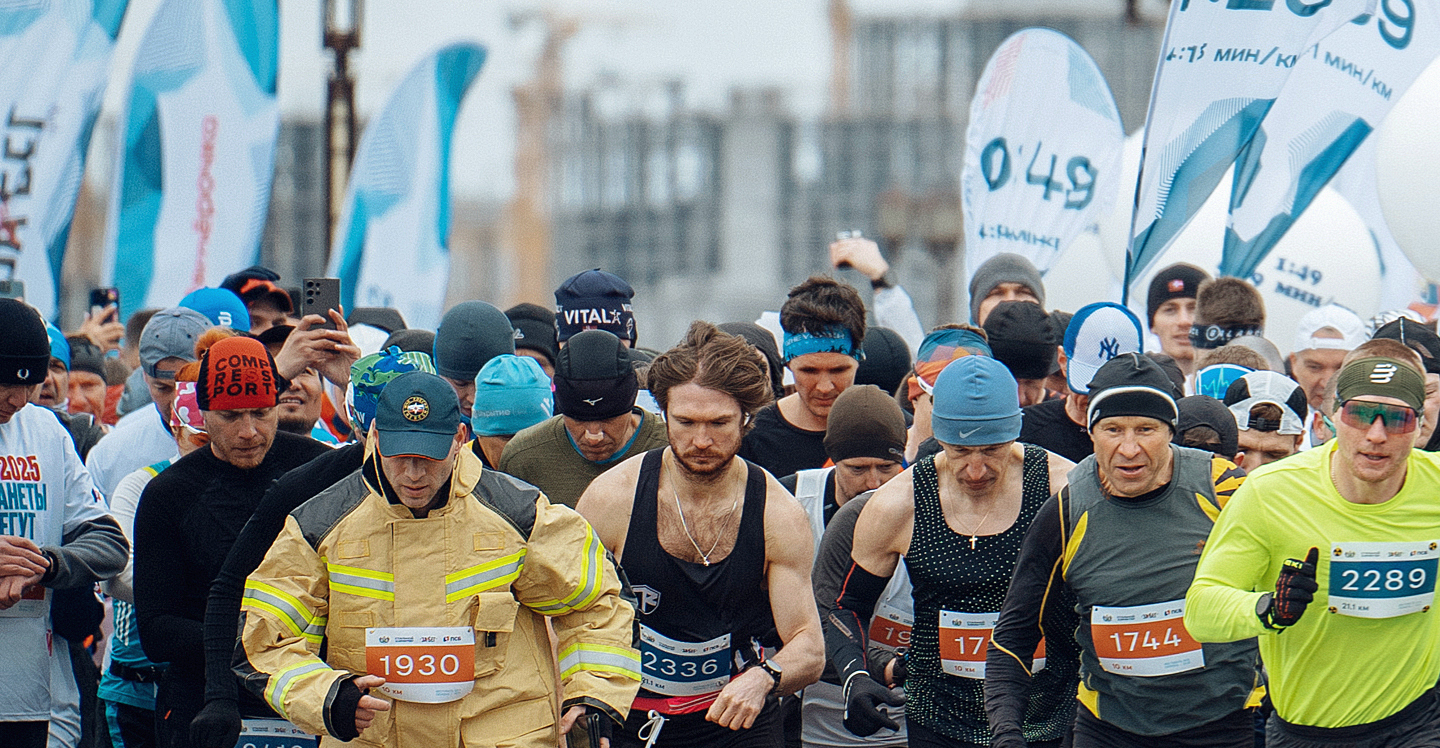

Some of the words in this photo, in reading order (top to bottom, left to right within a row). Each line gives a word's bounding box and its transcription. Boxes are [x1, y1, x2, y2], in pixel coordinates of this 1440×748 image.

[215, 355, 268, 371] COMP
[213, 382, 271, 398] PORT
[1341, 568, 1427, 591] 2289
[954, 636, 985, 655] 17
[1109, 627, 1182, 652] 1744
[379, 654, 460, 676] 1930
[643, 651, 718, 677] 2336
